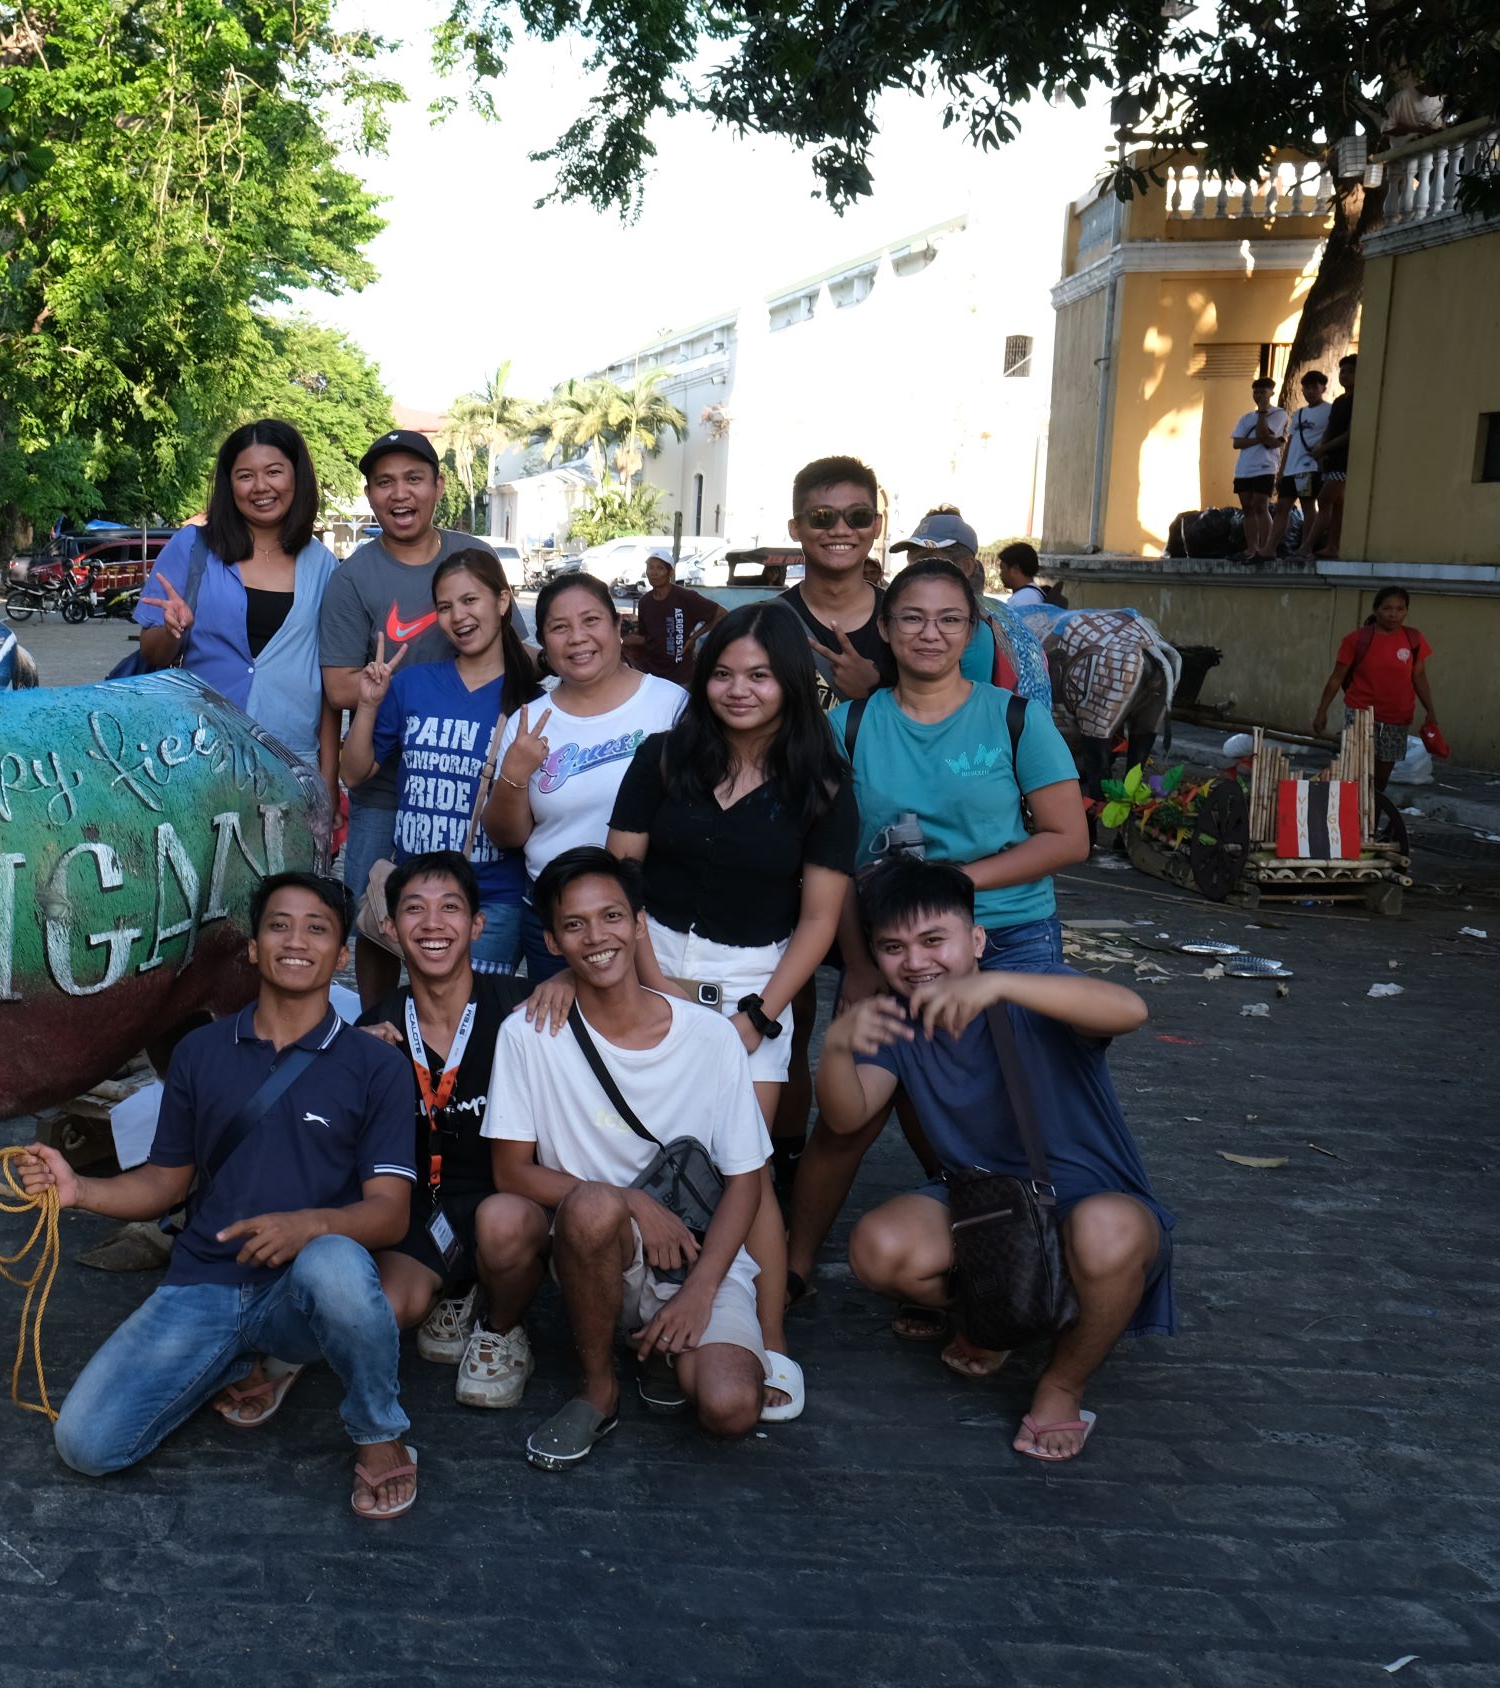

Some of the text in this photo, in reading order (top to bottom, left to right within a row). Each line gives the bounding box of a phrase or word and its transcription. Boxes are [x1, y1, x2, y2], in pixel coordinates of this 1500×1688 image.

[674, 607, 684, 664] AEROPOSTALE
[403, 715, 481, 752] PAIN
[538, 728, 647, 795] Guess
[404, 774, 471, 815] RIDE
[1327, 790, 1338, 845] VIGAN
[459, 1008, 472, 1036] STEM
